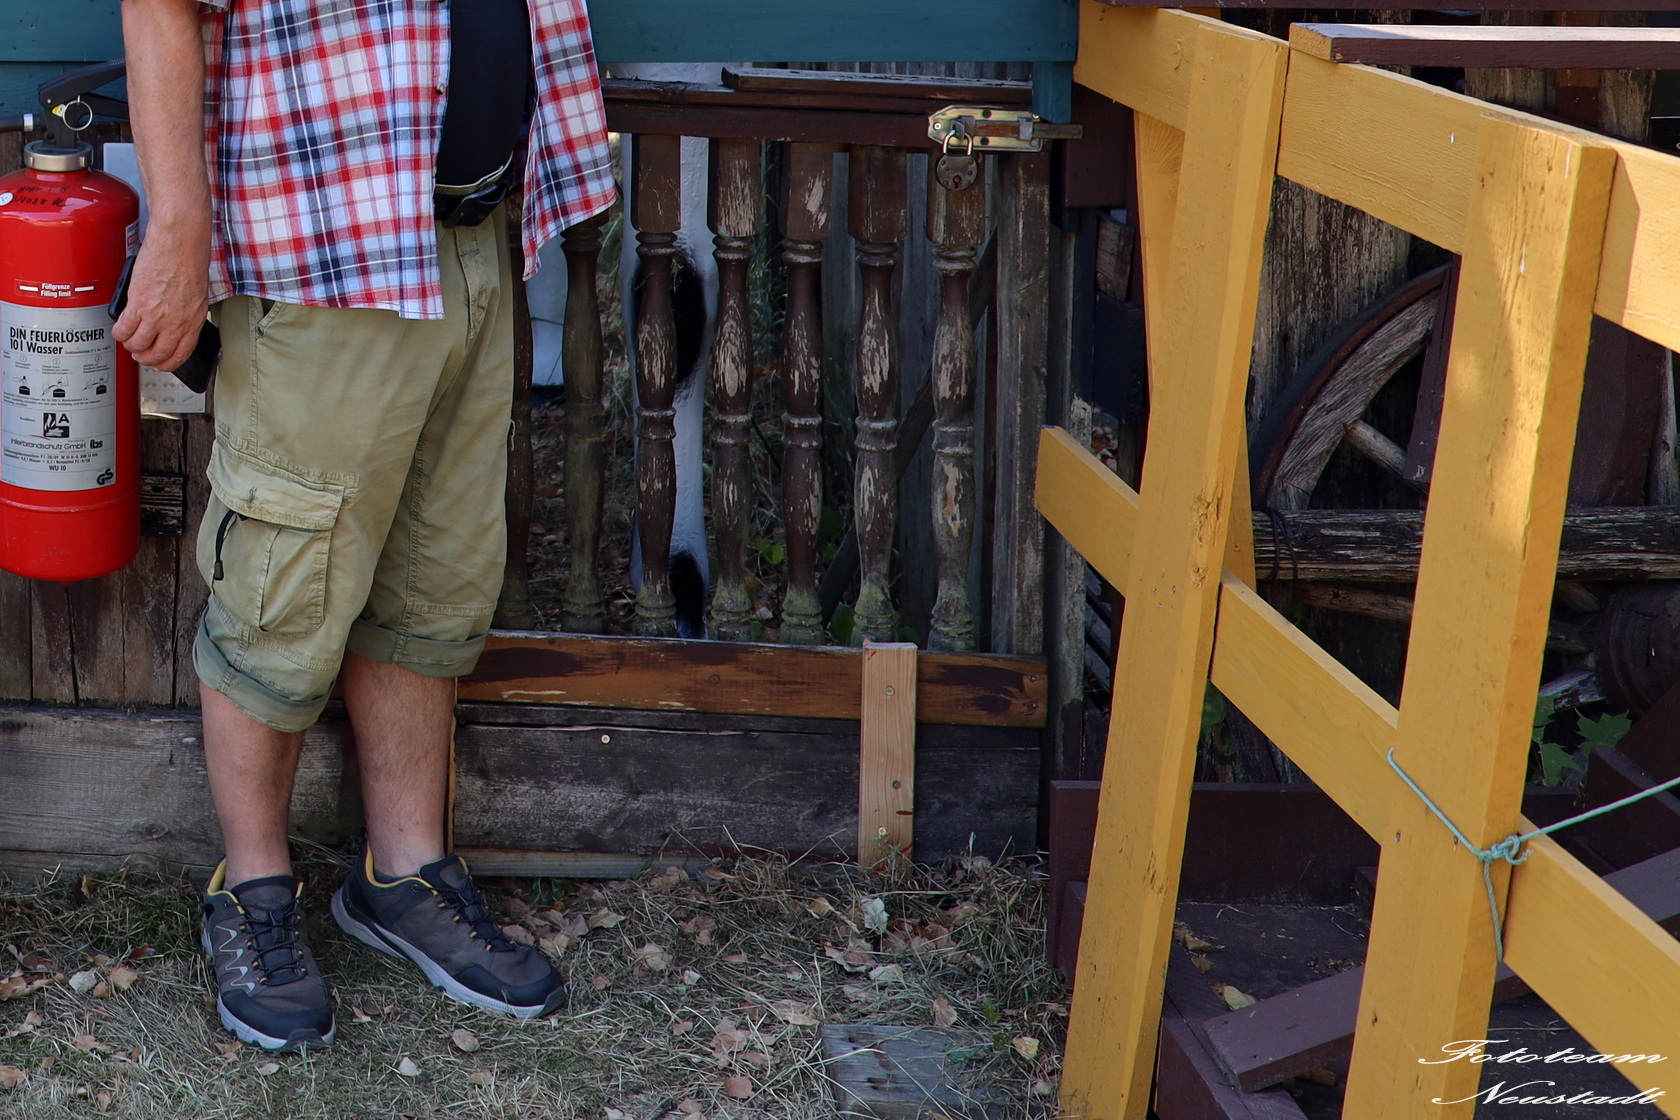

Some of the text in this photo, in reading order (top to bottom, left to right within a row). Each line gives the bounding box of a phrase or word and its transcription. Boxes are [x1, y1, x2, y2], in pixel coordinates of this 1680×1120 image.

[41, 290, 57, 298] Filling
[10, 327, 105, 343] DIN FEUERLÖSCHER
[10, 338, 19, 350] 10
[26, 341, 63, 355] Wasser
[58, 413, 70, 423] A
[89, 439, 103, 449] ibs
